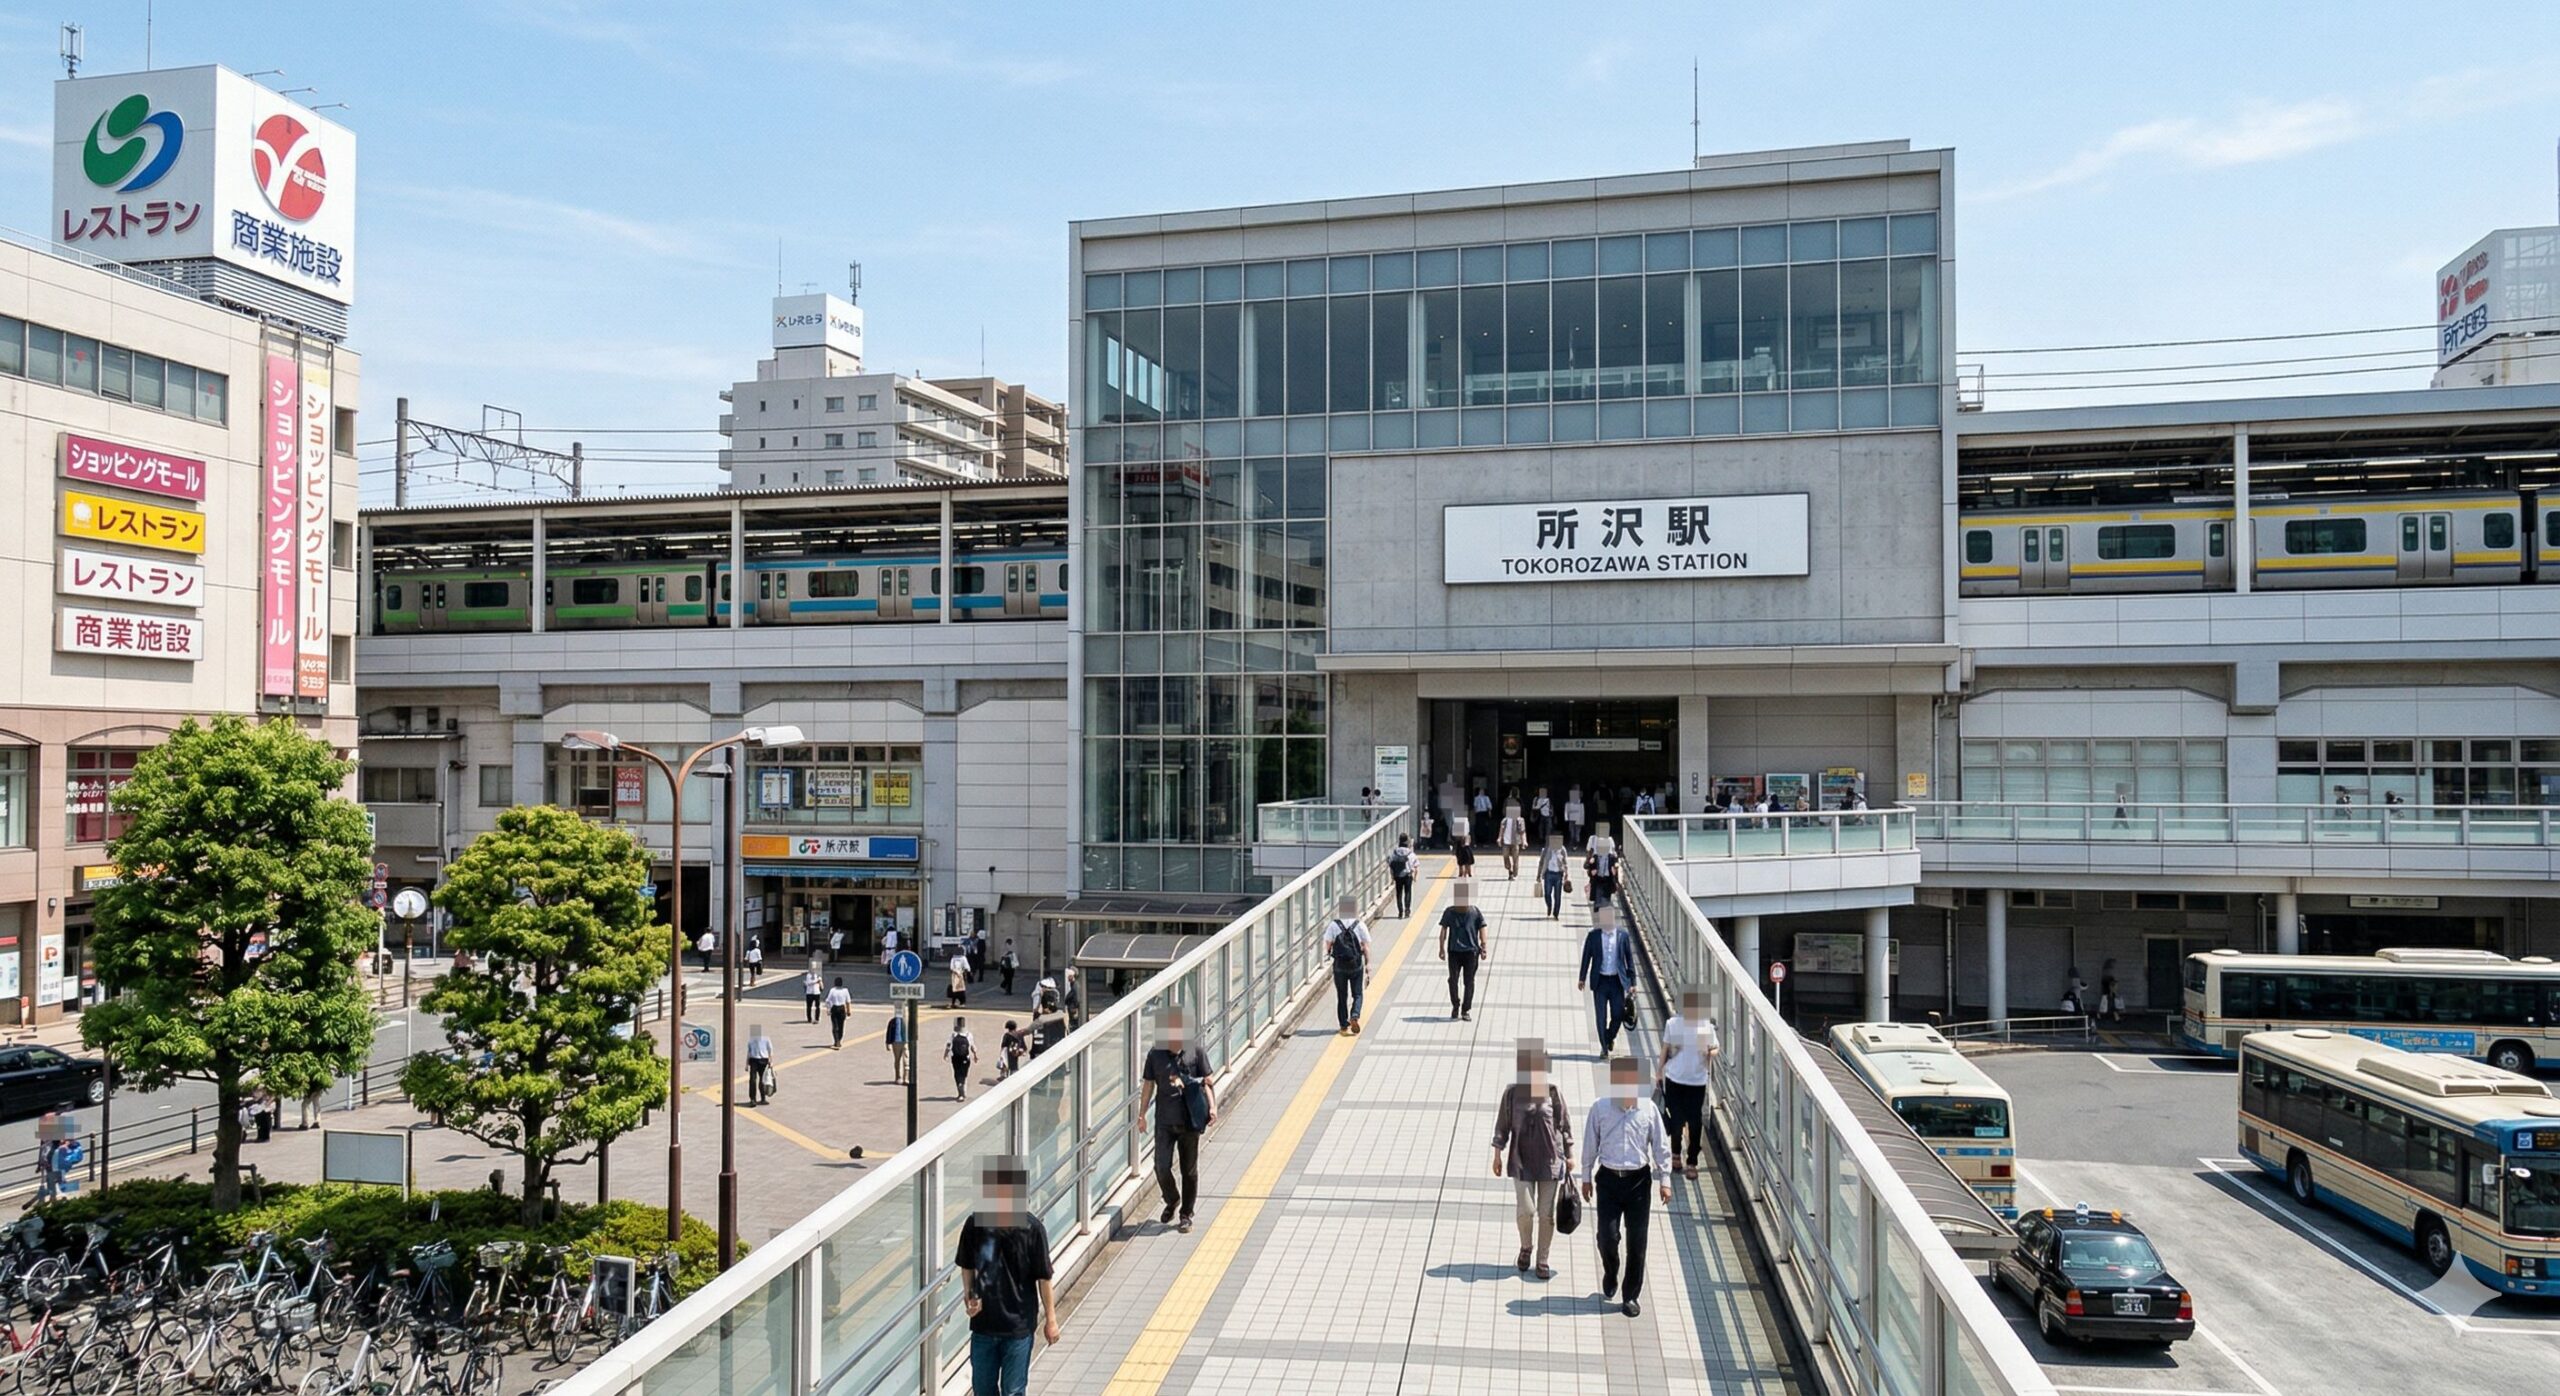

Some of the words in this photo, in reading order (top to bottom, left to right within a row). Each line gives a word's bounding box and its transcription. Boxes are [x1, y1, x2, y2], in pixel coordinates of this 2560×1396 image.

[63, 201, 201, 242] レストラン
[231, 208, 343, 283] 商業施設
[71, 443, 200, 493] ショッピングモール
[98, 505, 199, 543] レストラン
[268, 379, 294, 647] ショッピングモール
[303, 394, 327, 642] ショッピングモール
[1536, 505, 1711, 551] 所沢駅
[74, 557, 195, 597] レストラン
[1502, 555, 1650, 575] TOKOROZAWA
[1657, 552, 1748, 571] STATION
[75, 615, 192, 653] 商業施設
